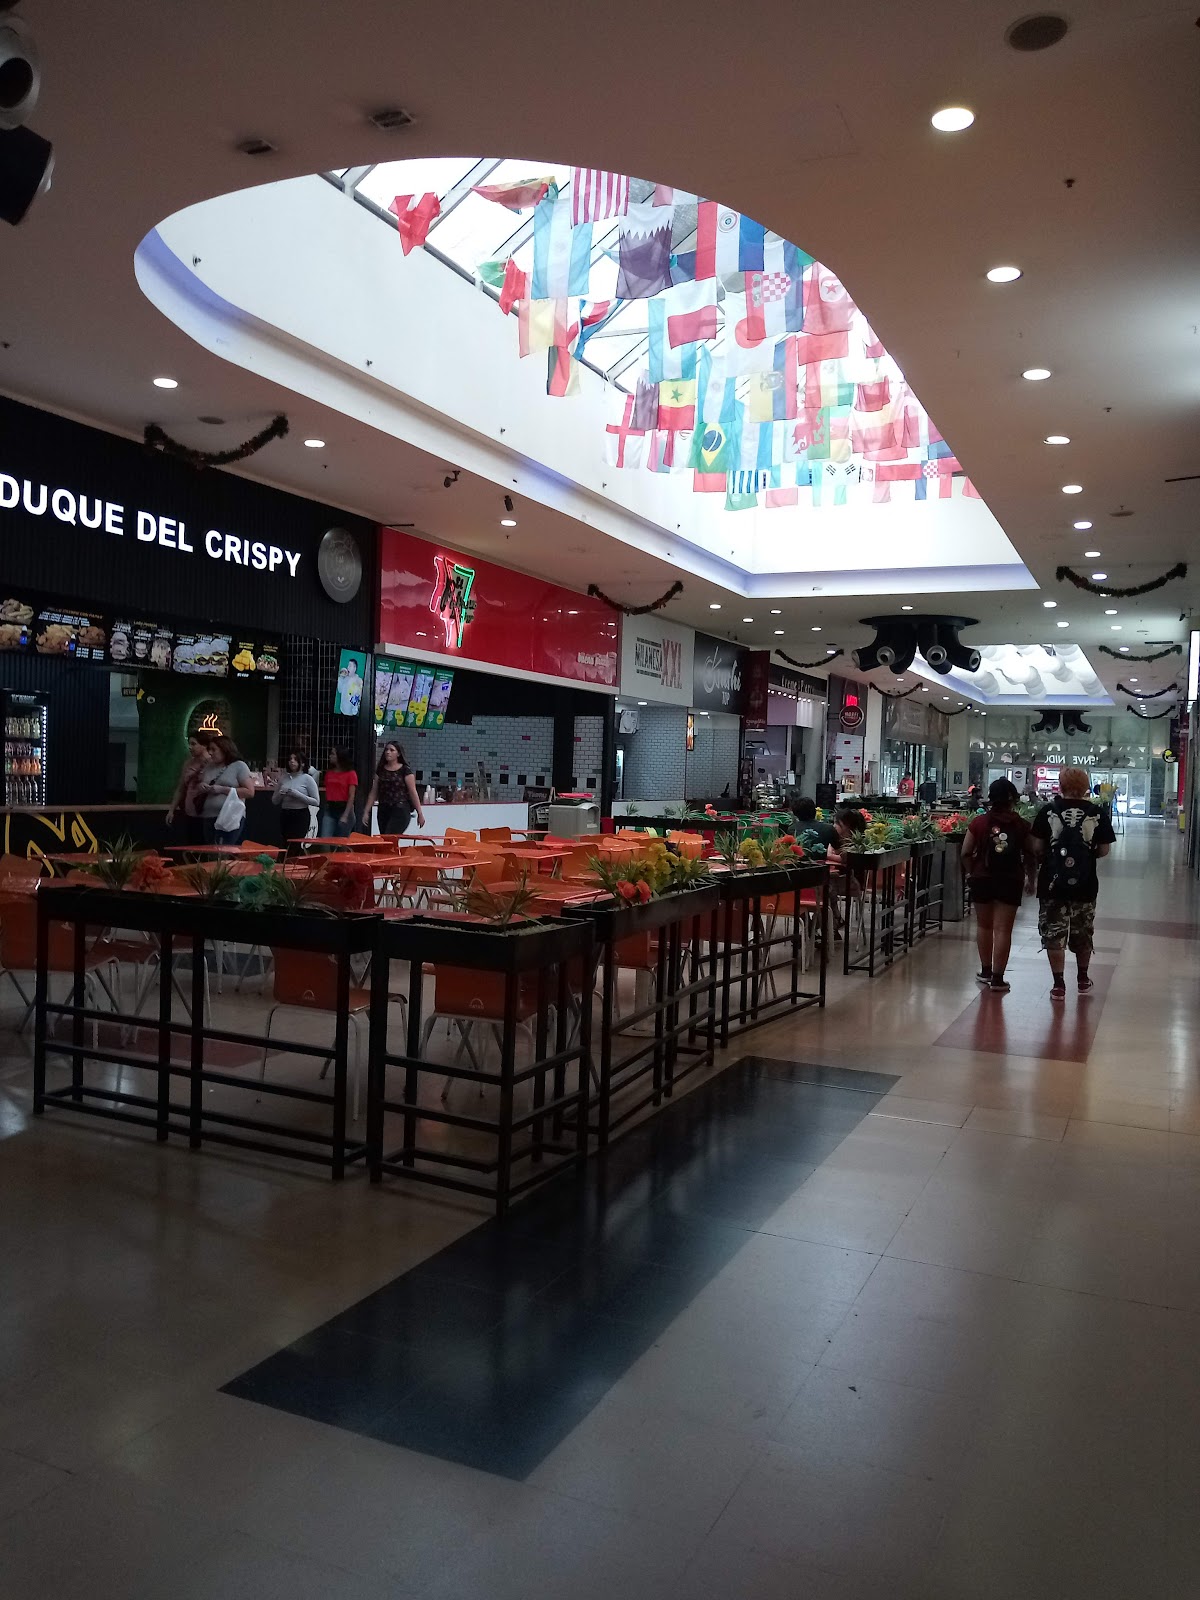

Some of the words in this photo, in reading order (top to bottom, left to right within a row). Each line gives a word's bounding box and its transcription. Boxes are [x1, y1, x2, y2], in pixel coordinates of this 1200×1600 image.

[0, 473, 124, 536] DUQUE
[138, 511, 194, 553] DEL
[206, 530, 302, 577] CRISPY
[635, 643, 662, 672] MILANESA
[662, 639, 682, 690] XXL
